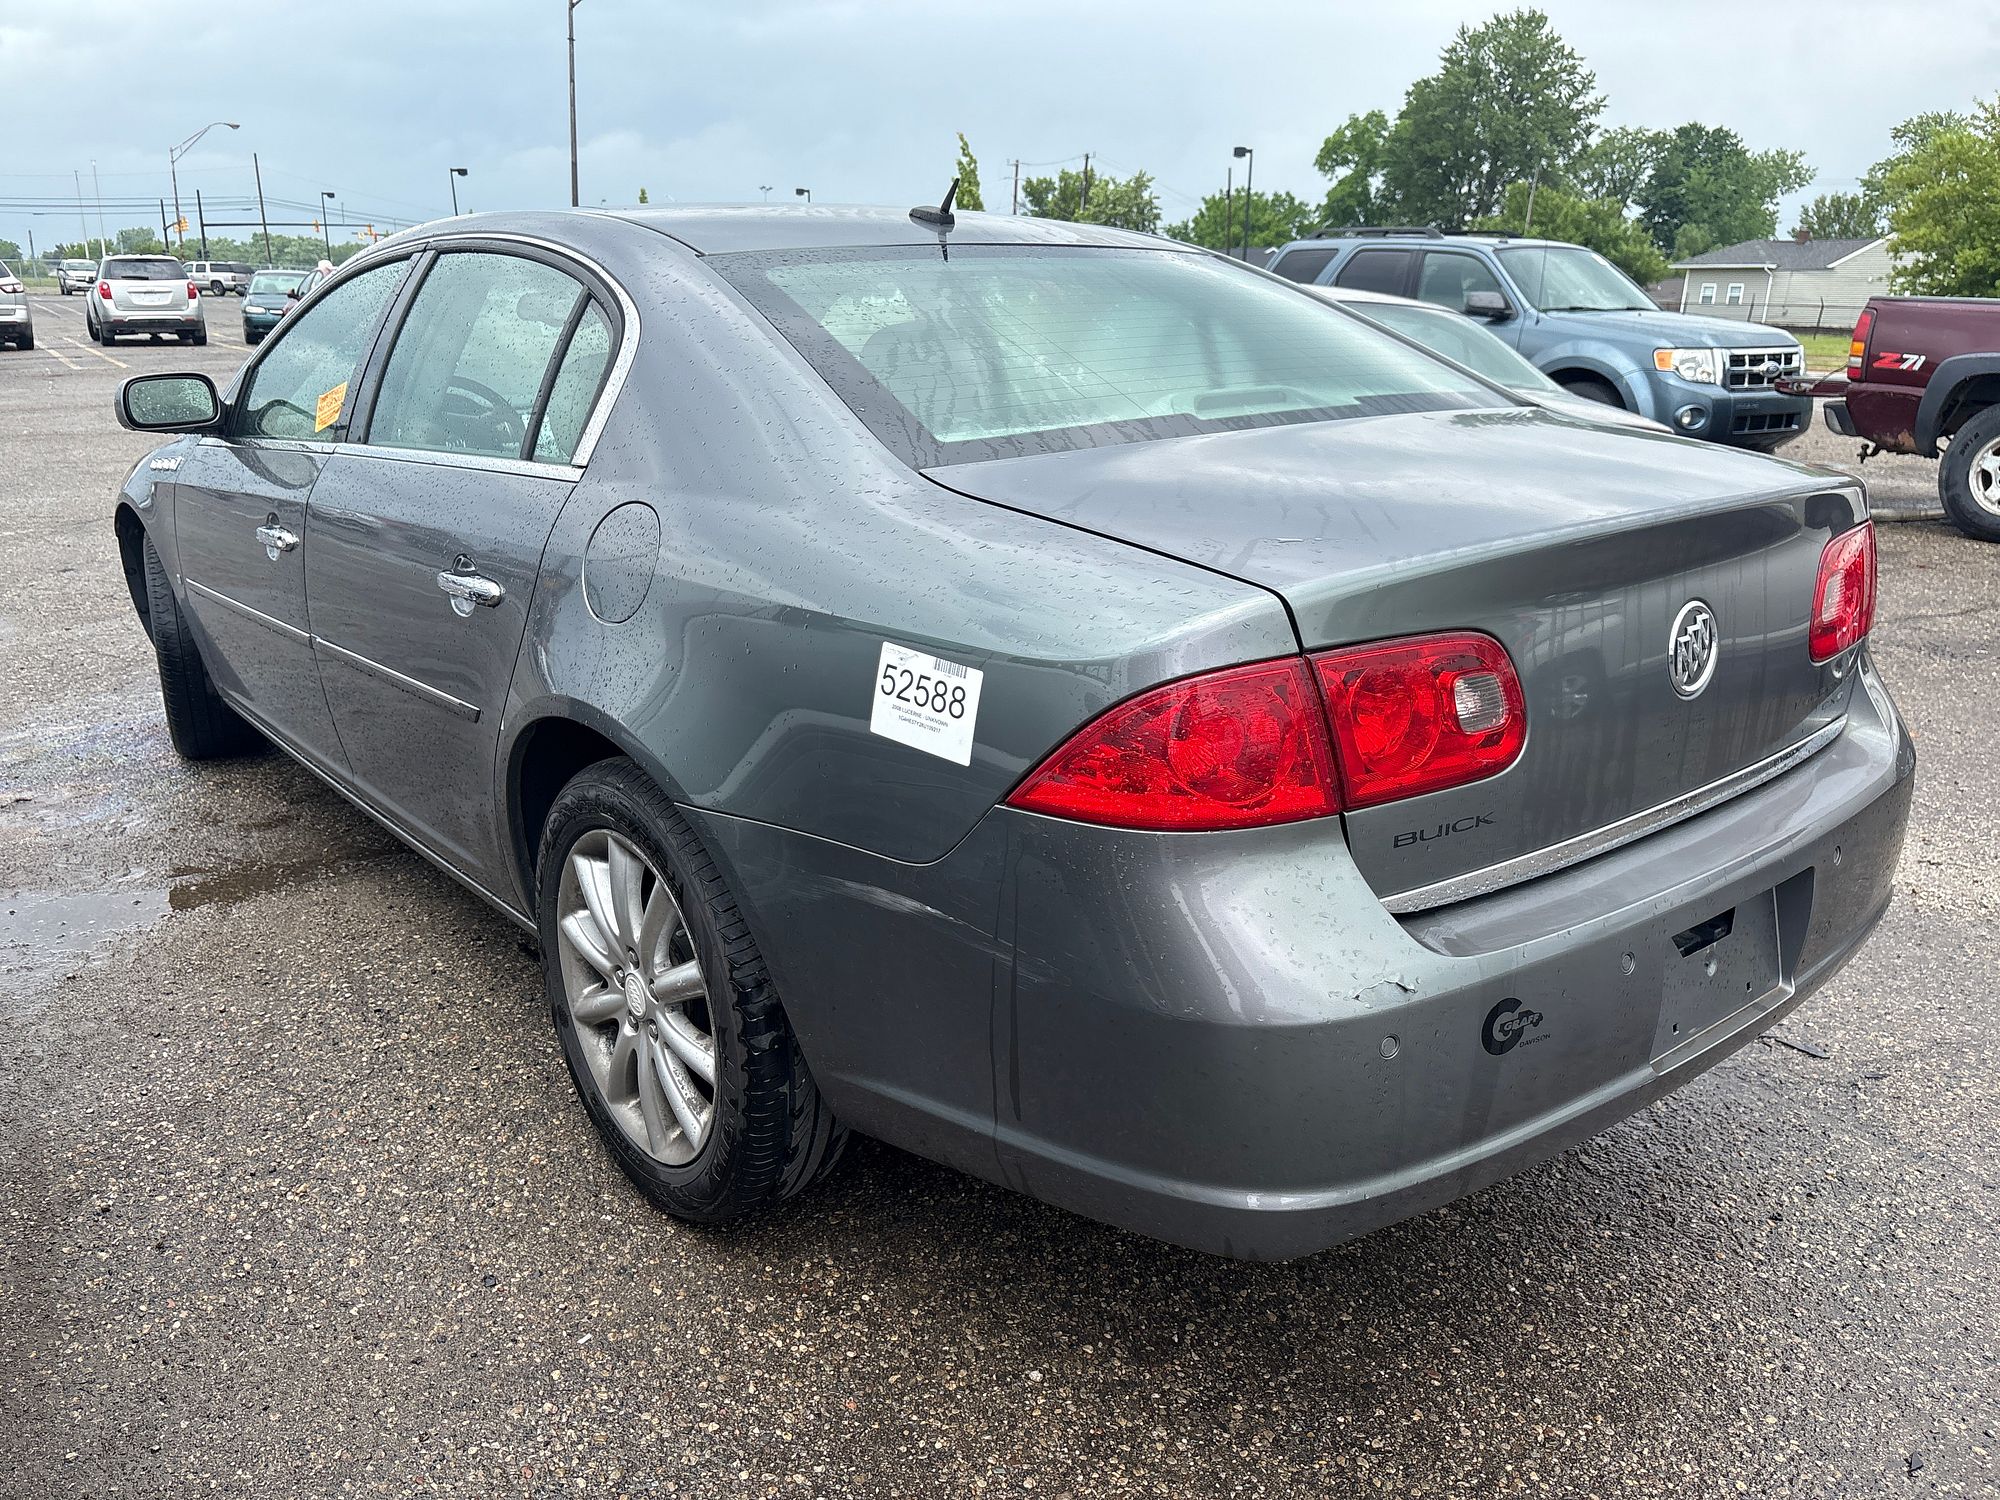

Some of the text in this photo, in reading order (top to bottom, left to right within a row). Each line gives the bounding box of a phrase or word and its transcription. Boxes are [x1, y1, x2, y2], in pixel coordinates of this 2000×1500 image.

[1873, 352, 1926, 371] Z71
[881, 663, 966, 719] 52588
[901, 706, 922, 718] LUCERNE
[925, 715, 948, 727] UNKNOWN
[1393, 811, 1496, 849] BUICK
[1503, 1013, 1540, 1031] GRAFF
[1519, 1033, 1551, 1048] DAVISON
